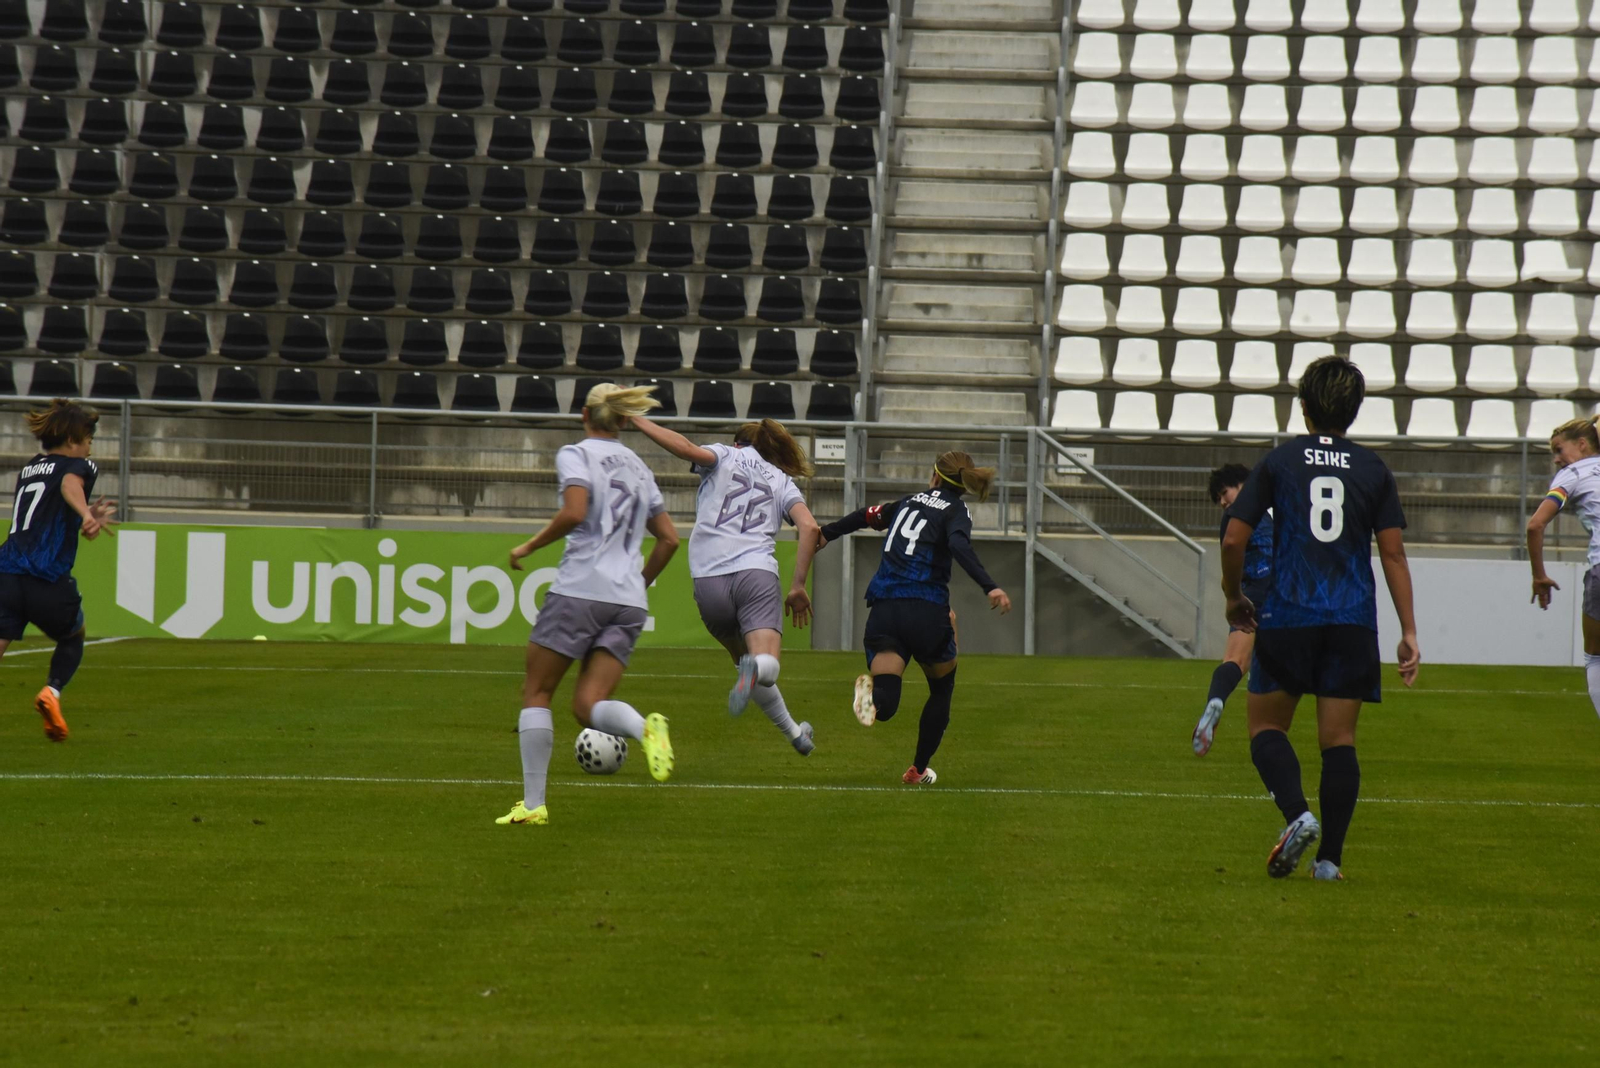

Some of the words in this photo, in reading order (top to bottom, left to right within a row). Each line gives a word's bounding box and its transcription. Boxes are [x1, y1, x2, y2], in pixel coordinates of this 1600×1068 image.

[21, 462, 56, 479] MAIKA
[1304, 448, 1351, 469] SEIKE
[10, 481, 46, 535] 17
[715, 472, 774, 534] 22
[1309, 475, 1345, 543] 8
[884, 506, 928, 556] 14
